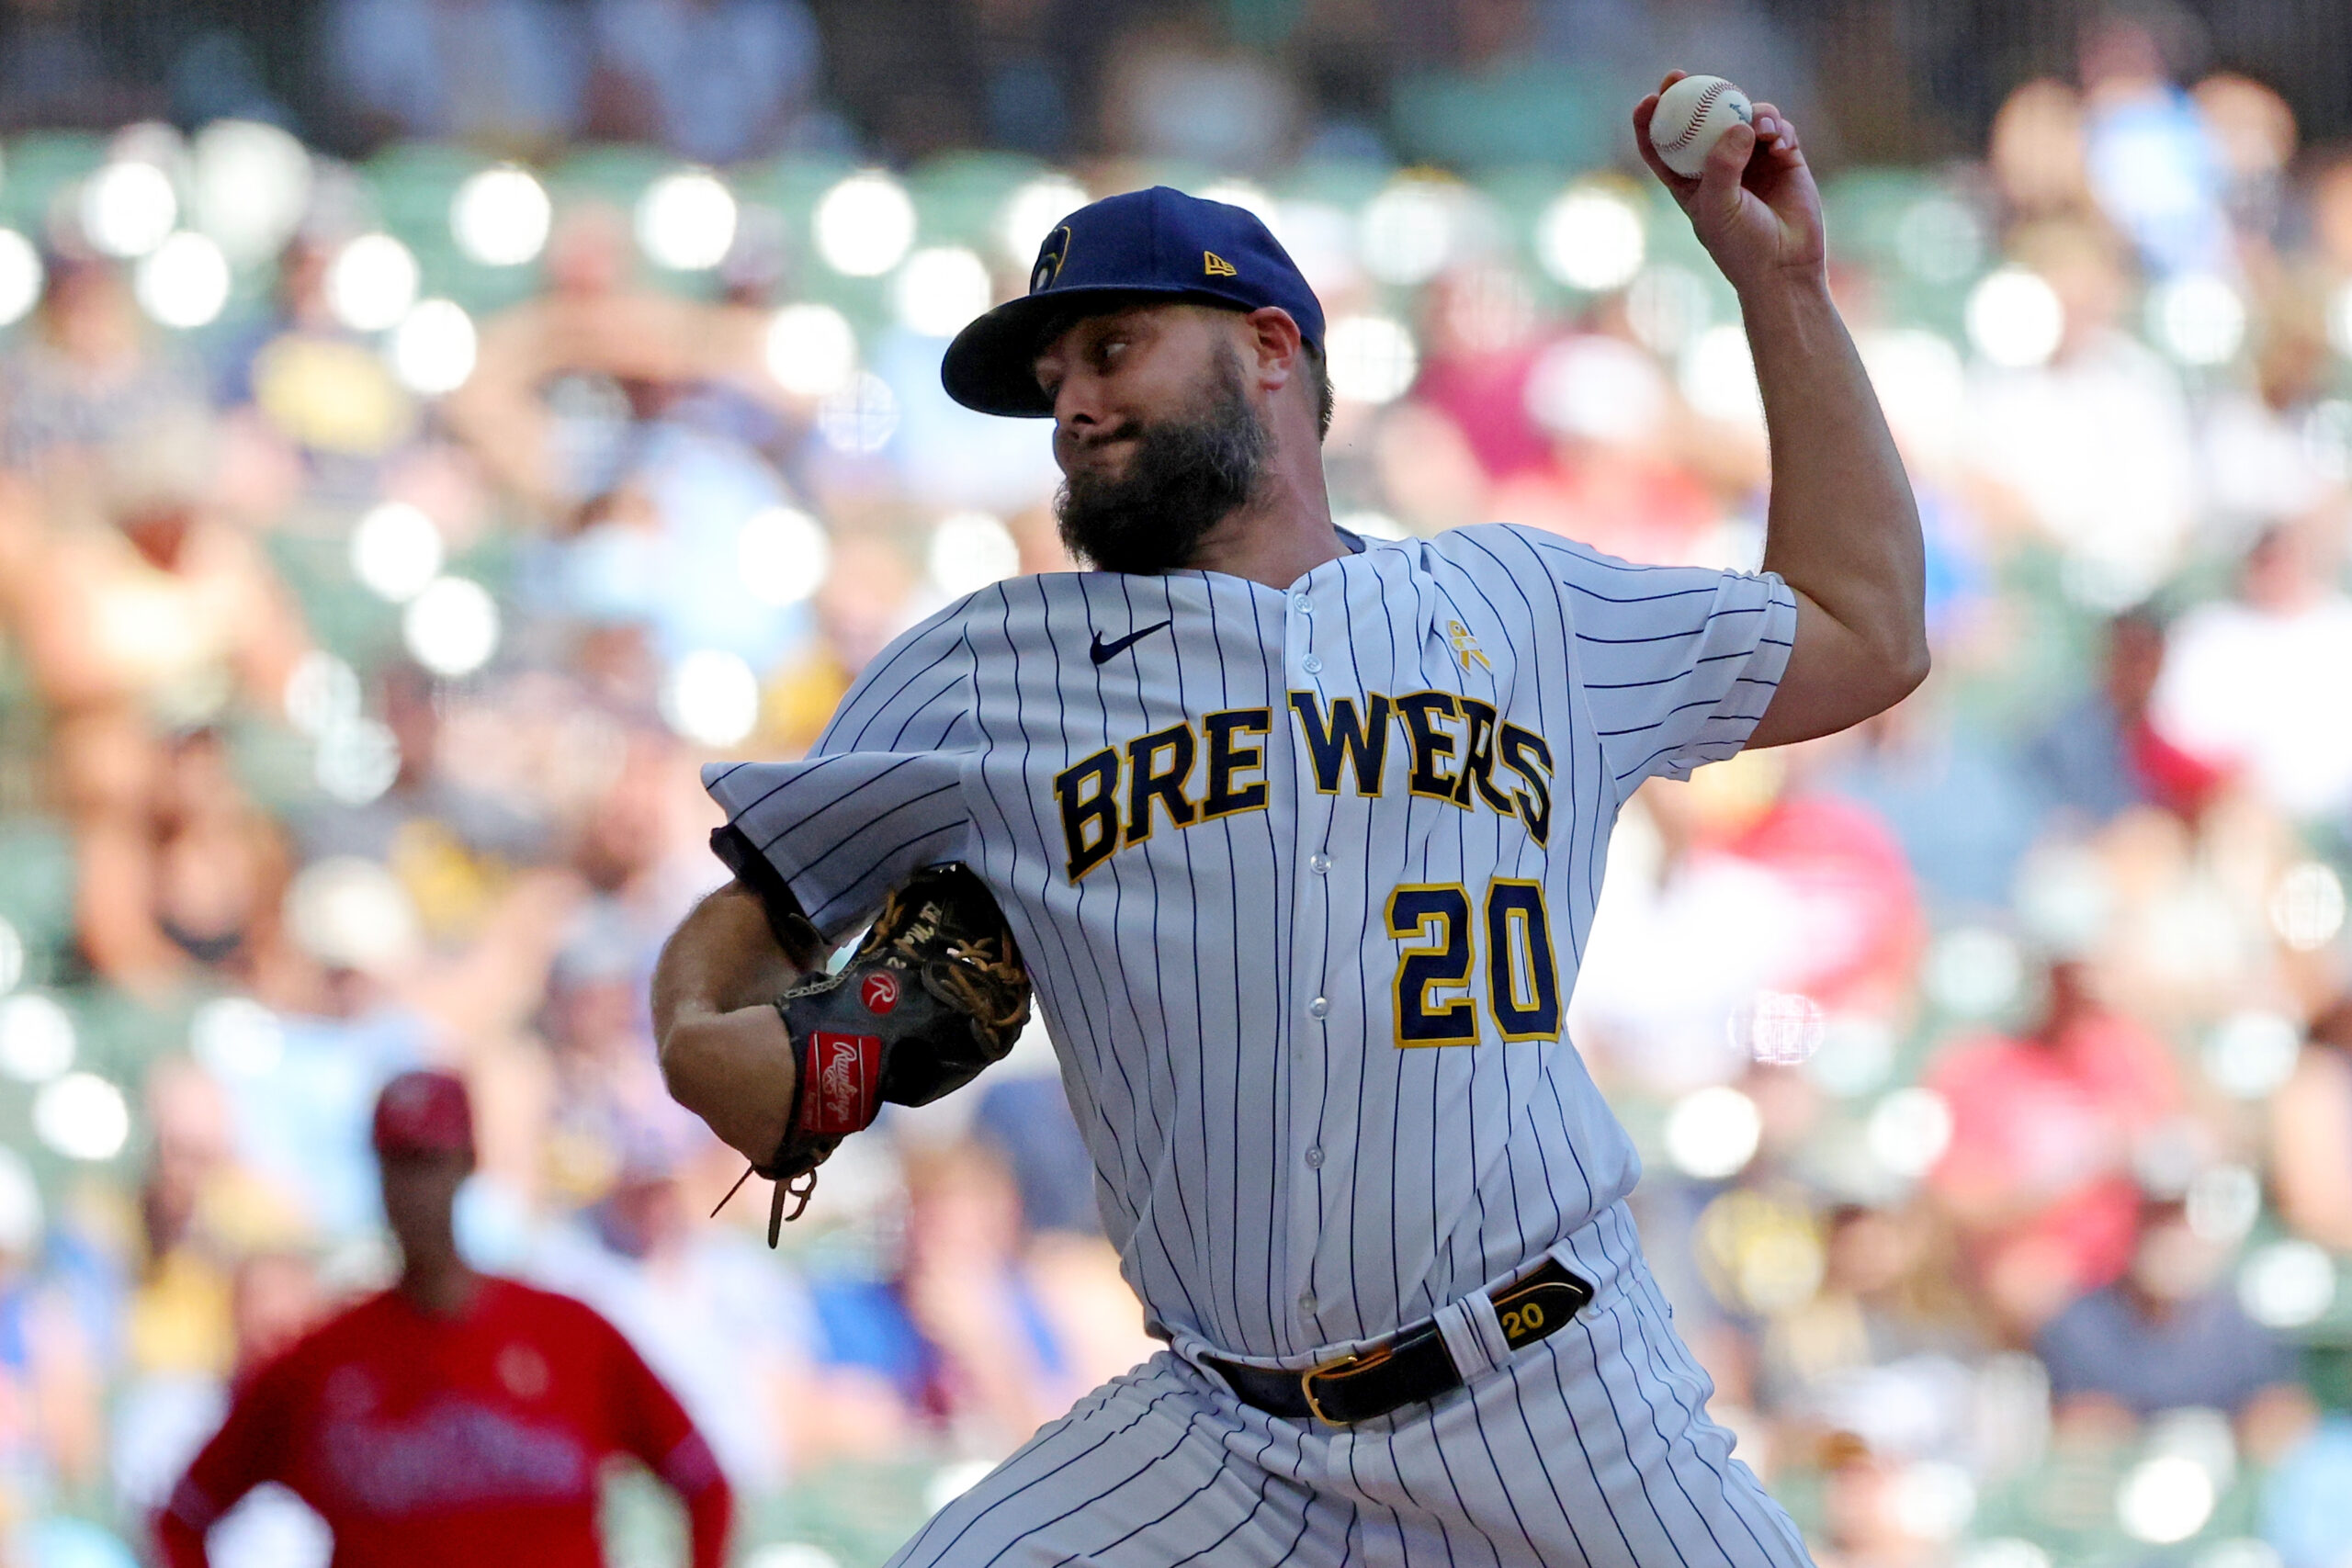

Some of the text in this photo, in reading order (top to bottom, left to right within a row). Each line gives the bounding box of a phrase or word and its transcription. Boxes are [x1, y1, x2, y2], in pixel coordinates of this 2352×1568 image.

[1053, 689, 1555, 887] BREWERS
[1384, 876, 1562, 1048] 20
[827, 1041, 858, 1123] Rawlings
[1501, 1303, 1544, 1339] 20
